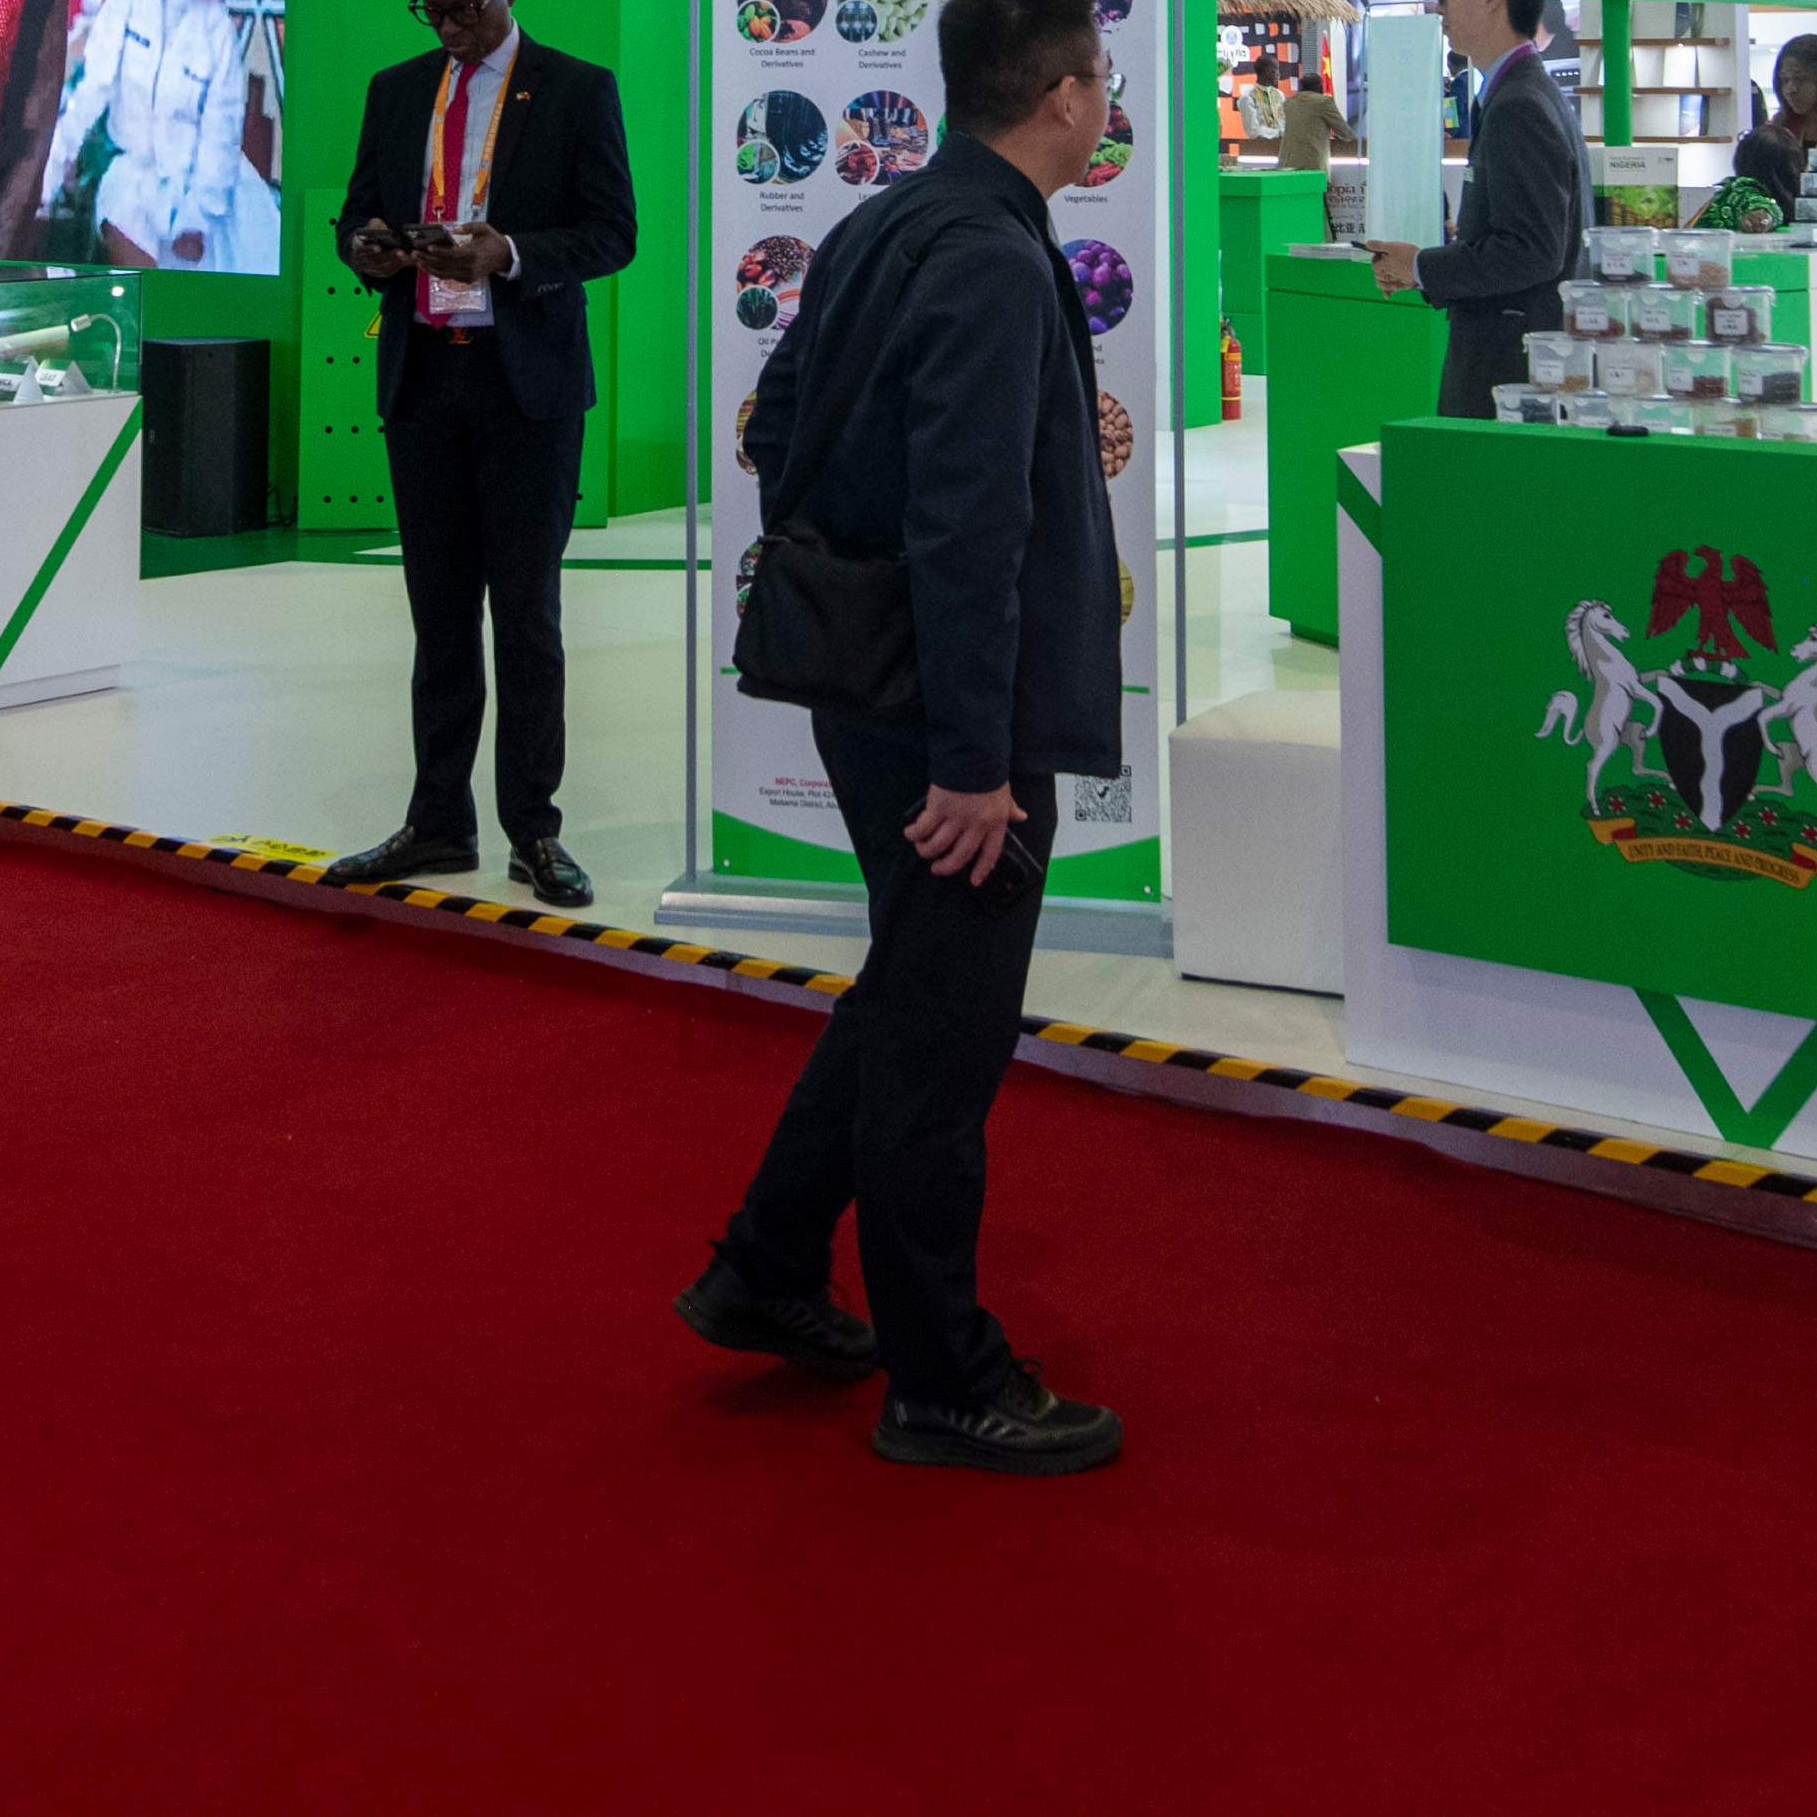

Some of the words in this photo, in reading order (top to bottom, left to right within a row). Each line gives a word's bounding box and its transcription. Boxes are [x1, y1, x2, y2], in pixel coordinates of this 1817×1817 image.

[749, 48, 773, 56] Cocoa
[775, 48, 799, 56] Beans
[800, 48, 815, 56] and
[858, 49, 888, 57] Cashew
[891, 49, 906, 57] and
[761, 60, 804, 68] Derivatives
[859, 61, 902, 69] Derivatives
[759, 192, 788, 200] Rubber
[789, 192, 804, 200] and
[1064, 195, 1108, 204] Vegetables
[761, 204, 804, 212] Derivatives
